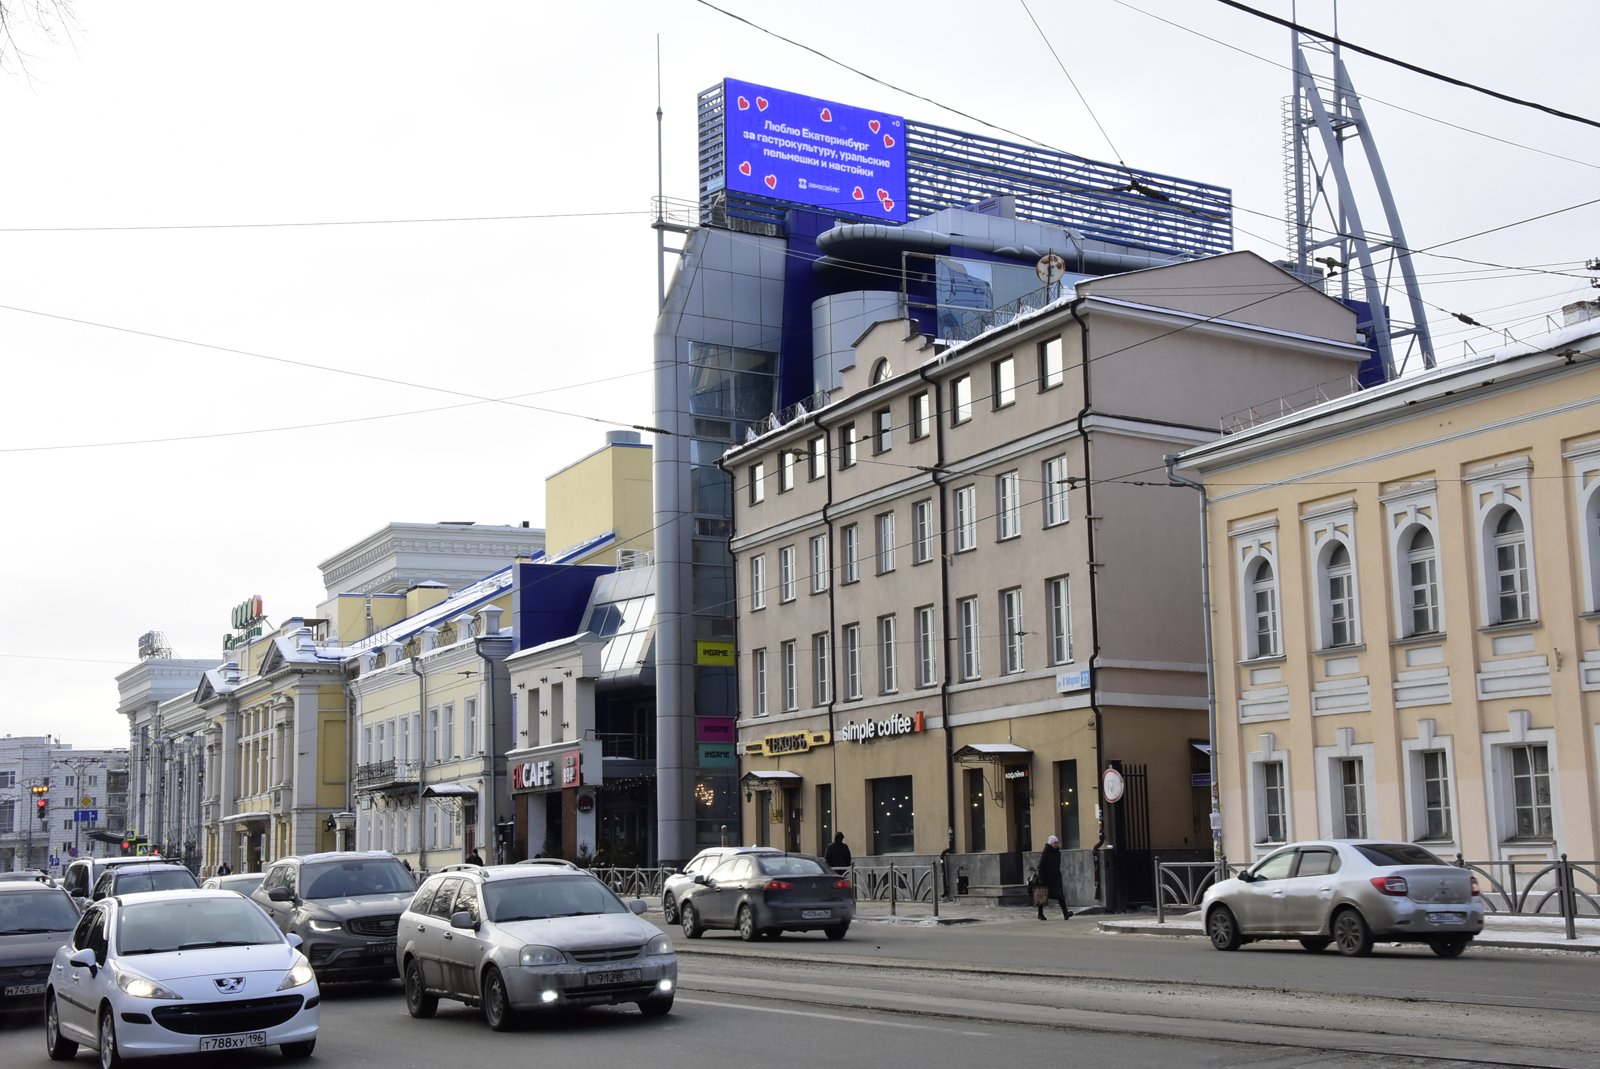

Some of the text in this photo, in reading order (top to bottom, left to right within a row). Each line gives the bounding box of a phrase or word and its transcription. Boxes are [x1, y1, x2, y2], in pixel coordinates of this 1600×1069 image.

[743, 131, 891, 168] за гастрокультуру, уральские
[764, 120, 870, 151] Люблю Екатеринбург
[764, 148, 874, 177] пельмешки и настойки
[703, 649, 728, 657] INGAME
[842, 713, 912, 745] simple coffee
[704, 751, 730, 759] INGAME
[205, 1034, 263, 1050] Т788ХУ 196
